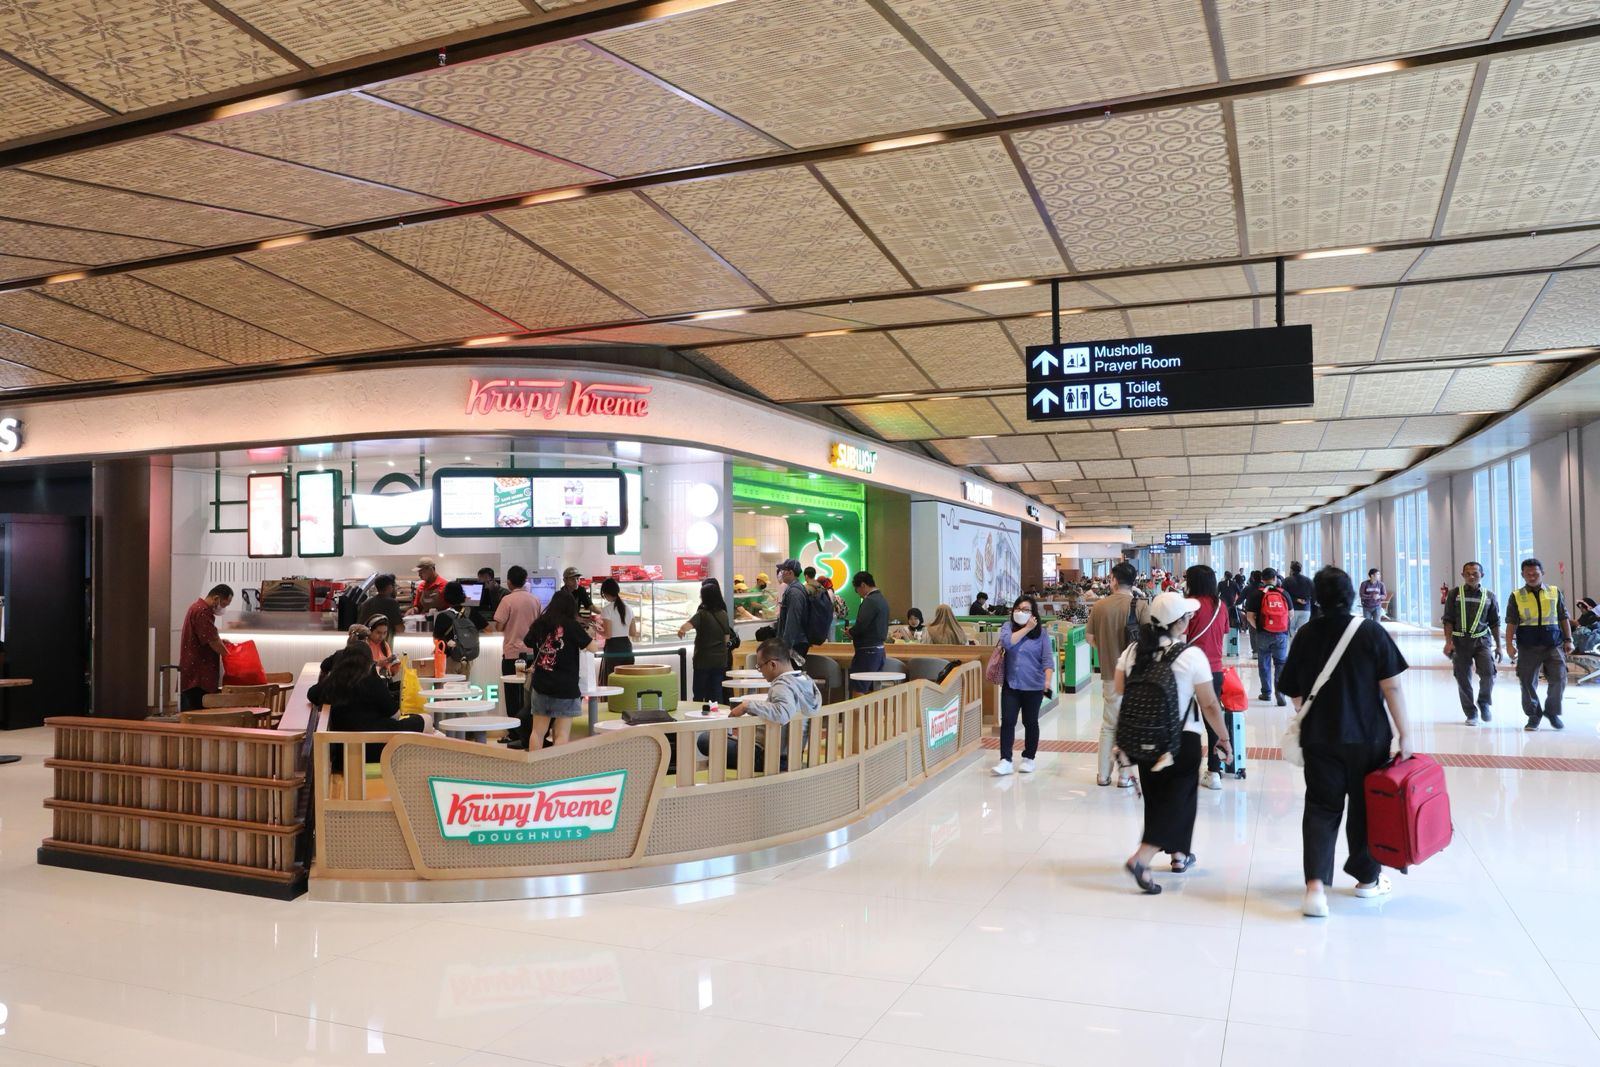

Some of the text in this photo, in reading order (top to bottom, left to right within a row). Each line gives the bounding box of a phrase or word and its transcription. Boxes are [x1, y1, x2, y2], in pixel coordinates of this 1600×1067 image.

[1094, 343, 1153, 358] Musholla
[1094, 357, 1181, 373] Prayer Room
[1125, 381, 1160, 394] Toilet
[465, 379, 653, 420] Krispy Kreme
[1125, 395, 1169, 409] Toilets
[446, 787, 617, 828] Krispy Kreme
[477, 829, 583, 843] DOUGHNUTS
